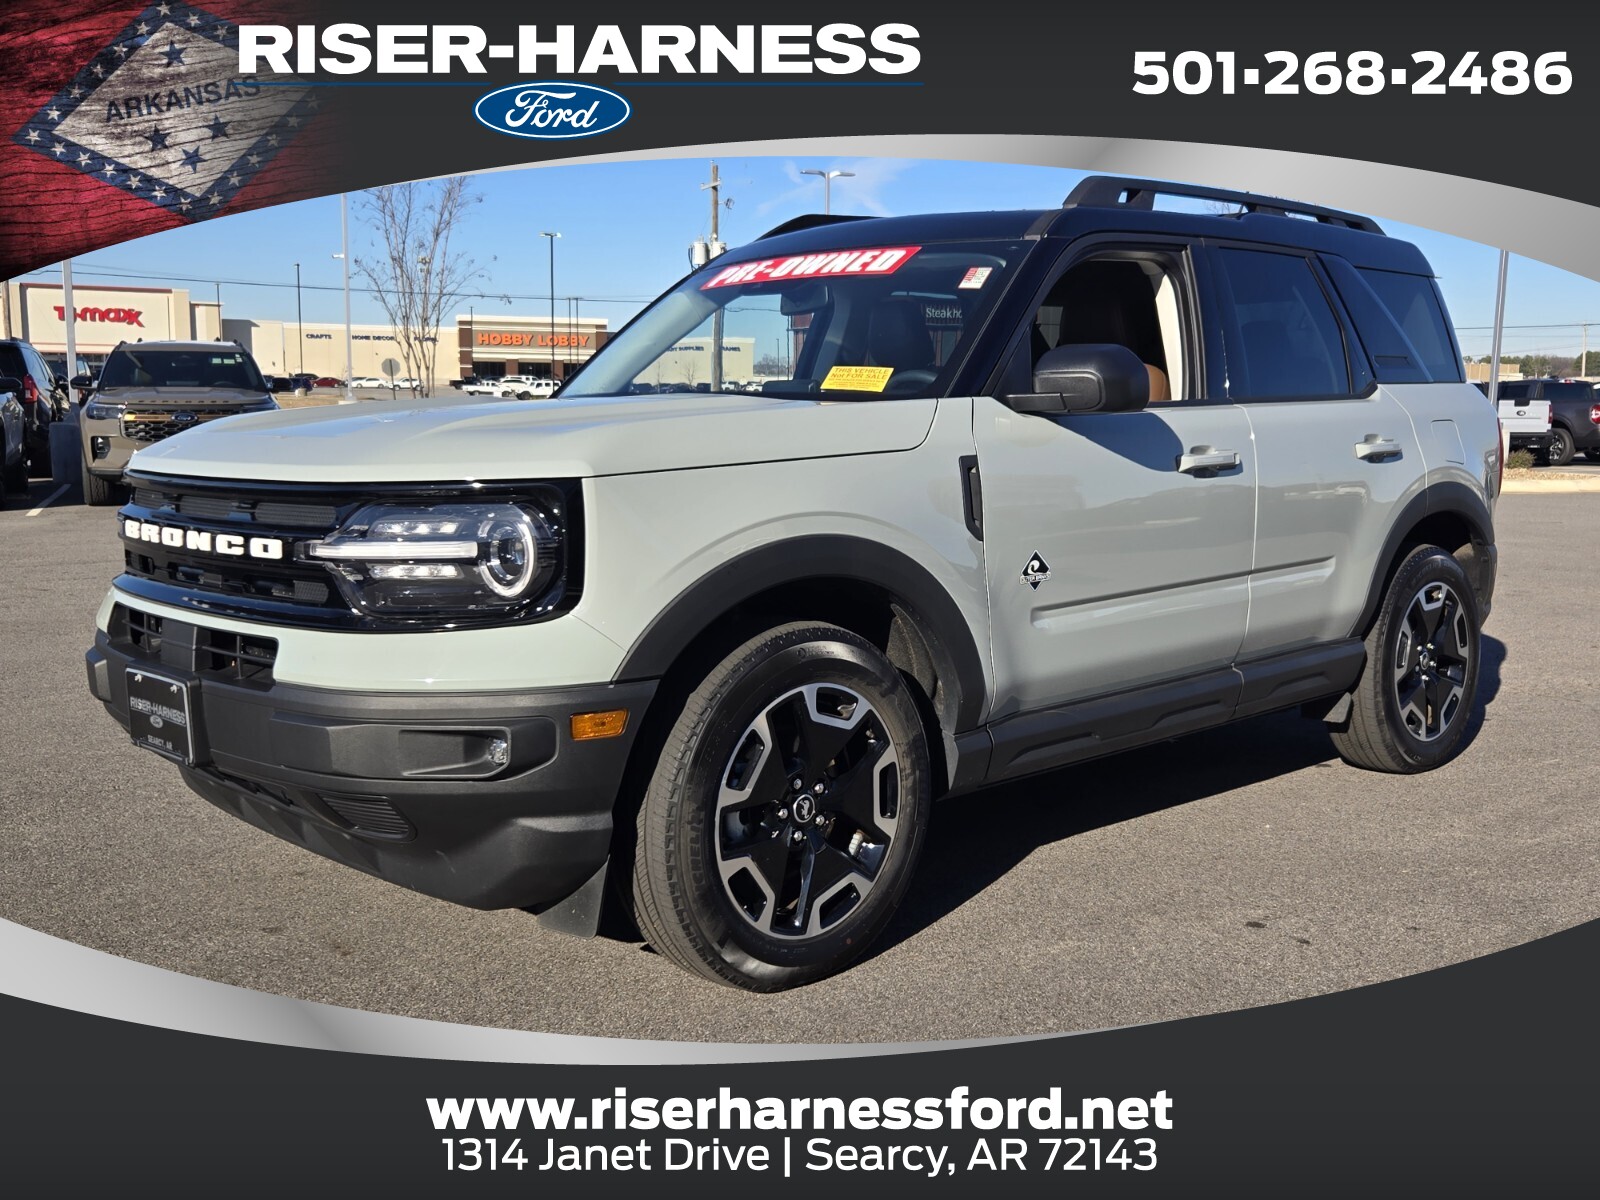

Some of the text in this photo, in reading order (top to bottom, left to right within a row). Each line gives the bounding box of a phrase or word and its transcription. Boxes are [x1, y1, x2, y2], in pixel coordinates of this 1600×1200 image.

[707, 250, 906, 287] PRE-OWNED
[478, 332, 590, 347] HOBBY LOBBY
[854, 367, 890, 375] VEHICLE
[124, 519, 283, 560] BRONCO
[129, 696, 187, 725] RISER-HARNESS
